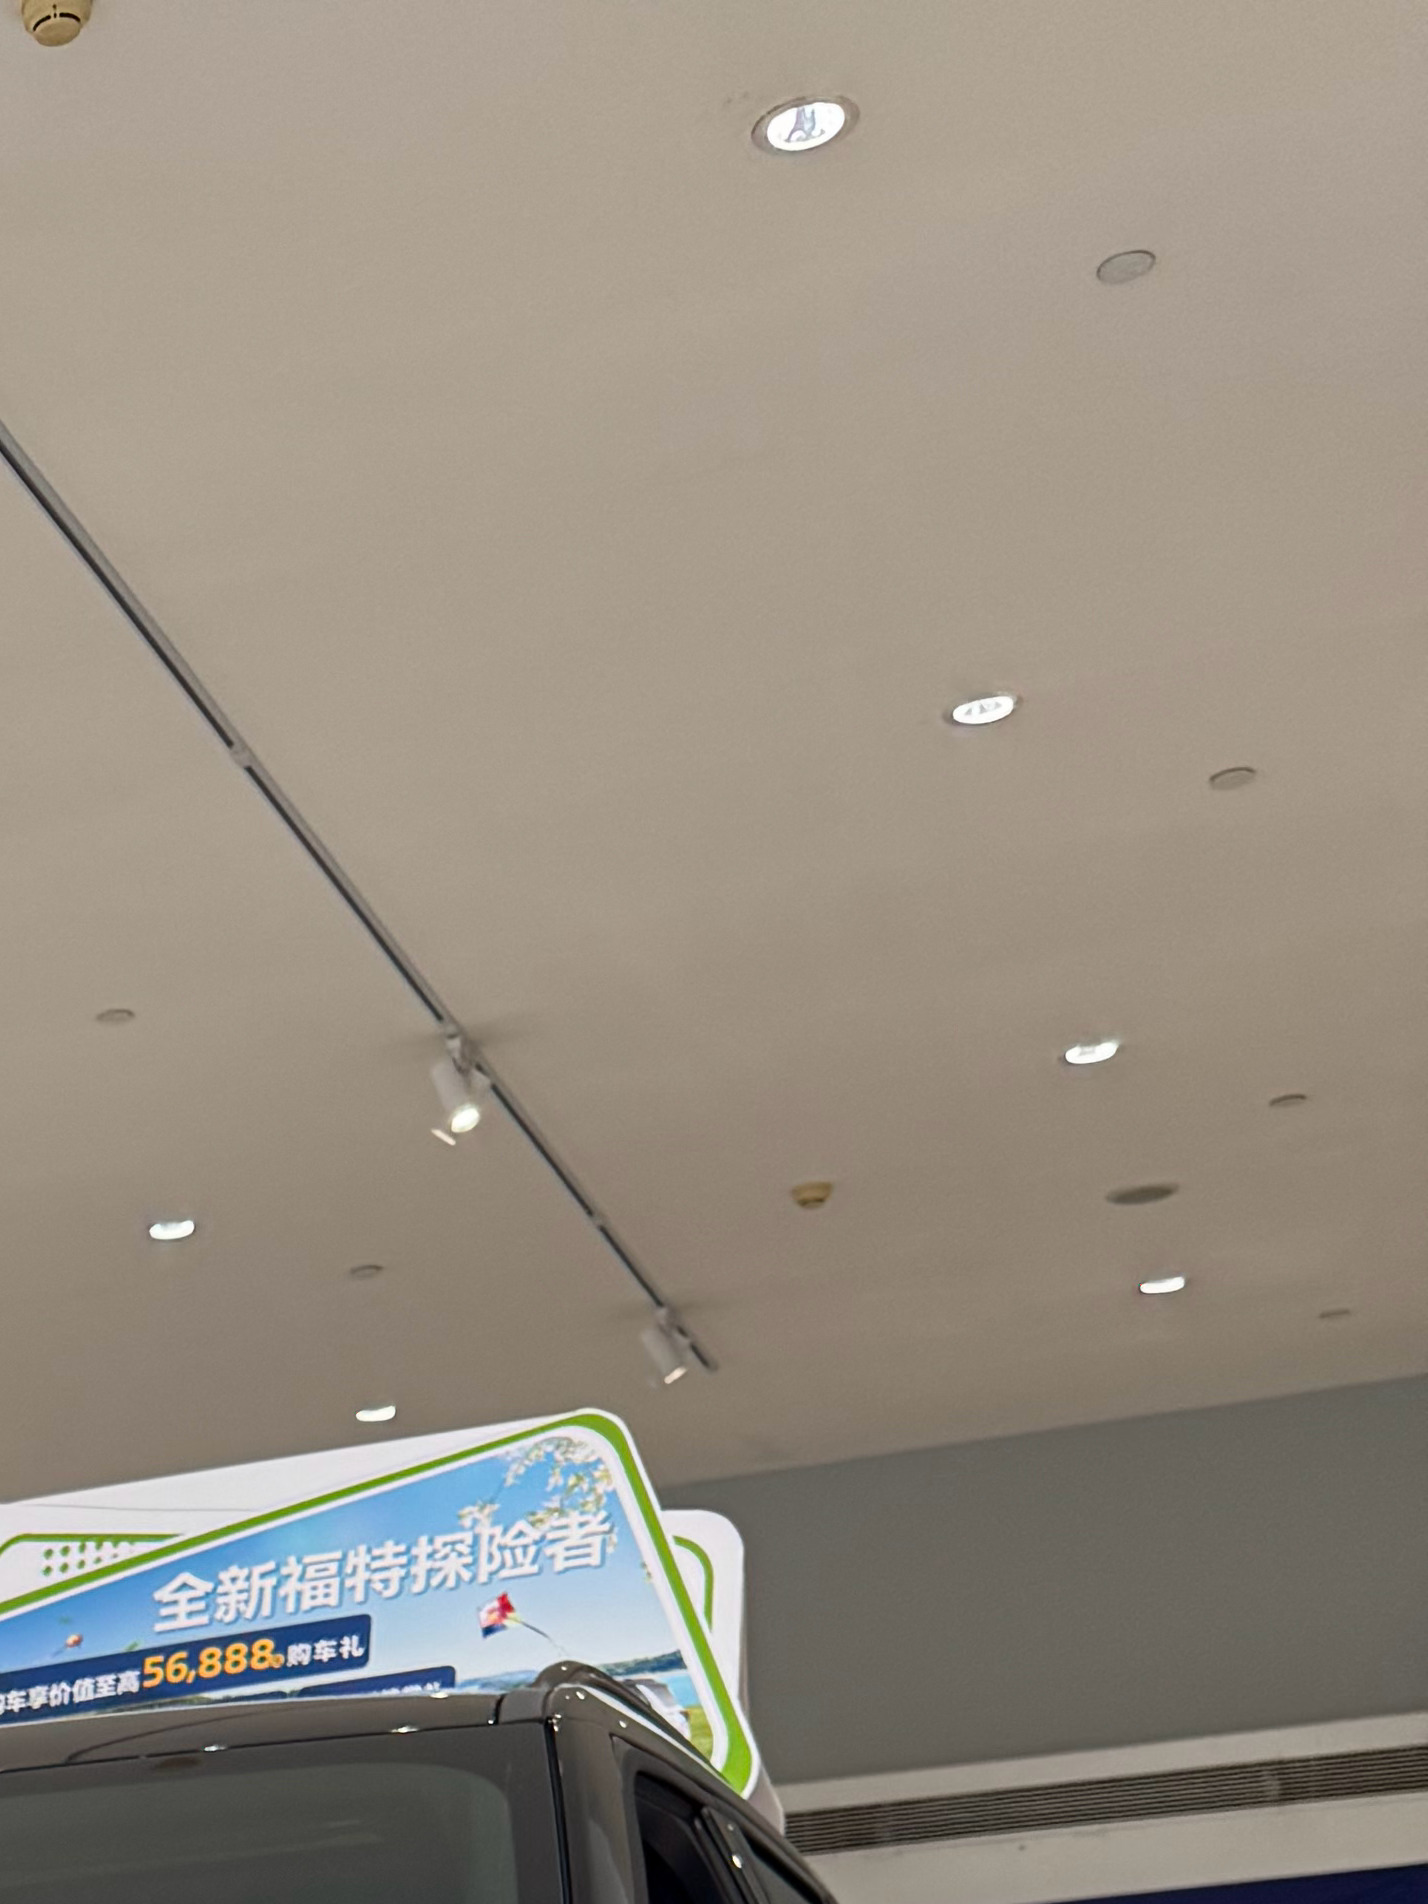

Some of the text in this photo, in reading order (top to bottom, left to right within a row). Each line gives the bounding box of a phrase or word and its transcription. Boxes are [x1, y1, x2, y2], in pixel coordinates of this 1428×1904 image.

[151, 1508, 618, 1635] 全新福特探险者
